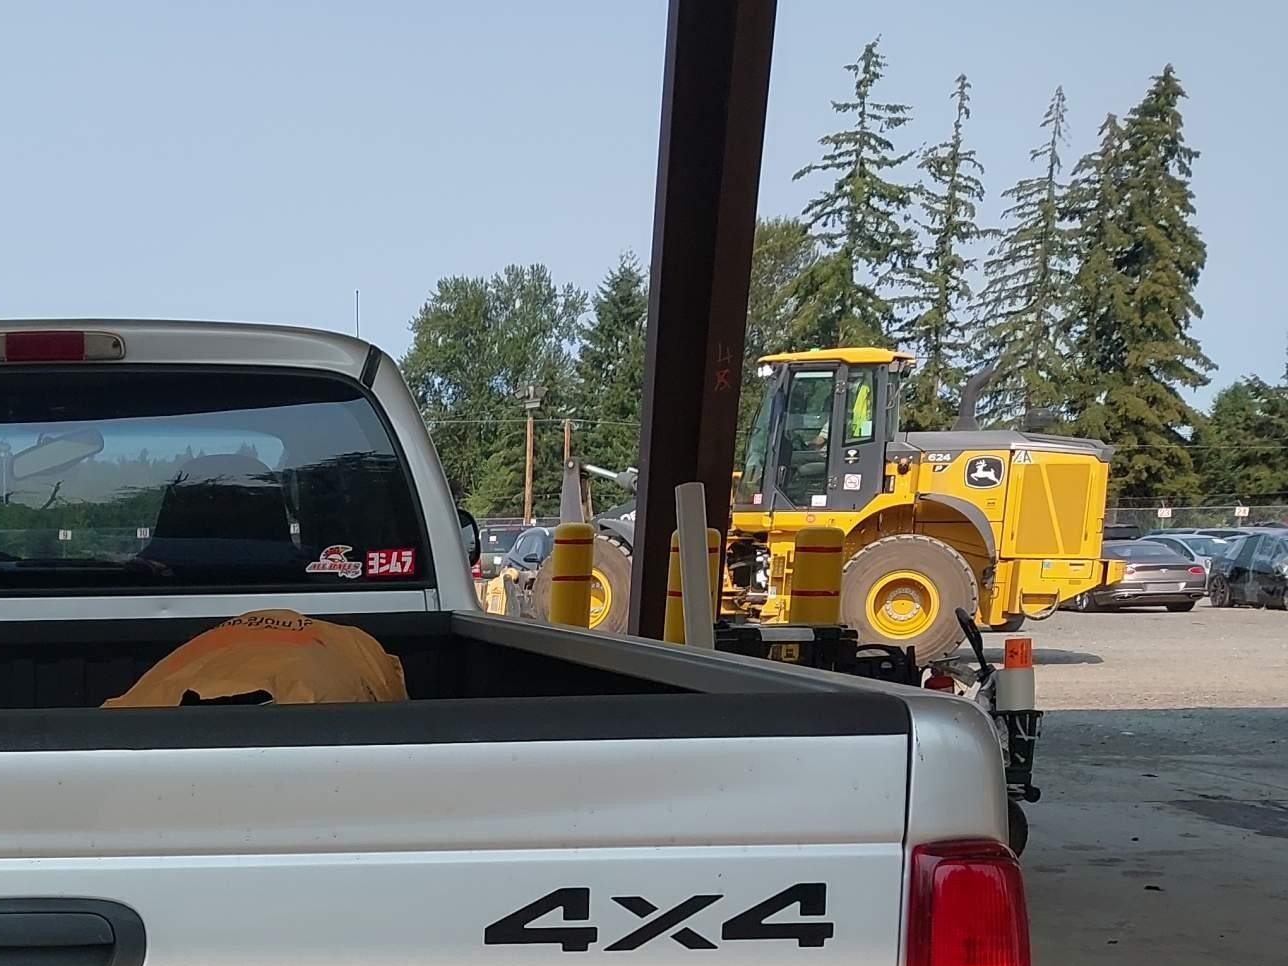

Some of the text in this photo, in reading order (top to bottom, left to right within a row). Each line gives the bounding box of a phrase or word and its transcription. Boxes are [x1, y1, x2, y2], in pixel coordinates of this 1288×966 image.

[928, 453, 951, 462] 624
[368, 551, 413, 574] ヨシムラ
[485, 883, 833, 951] 4X4
